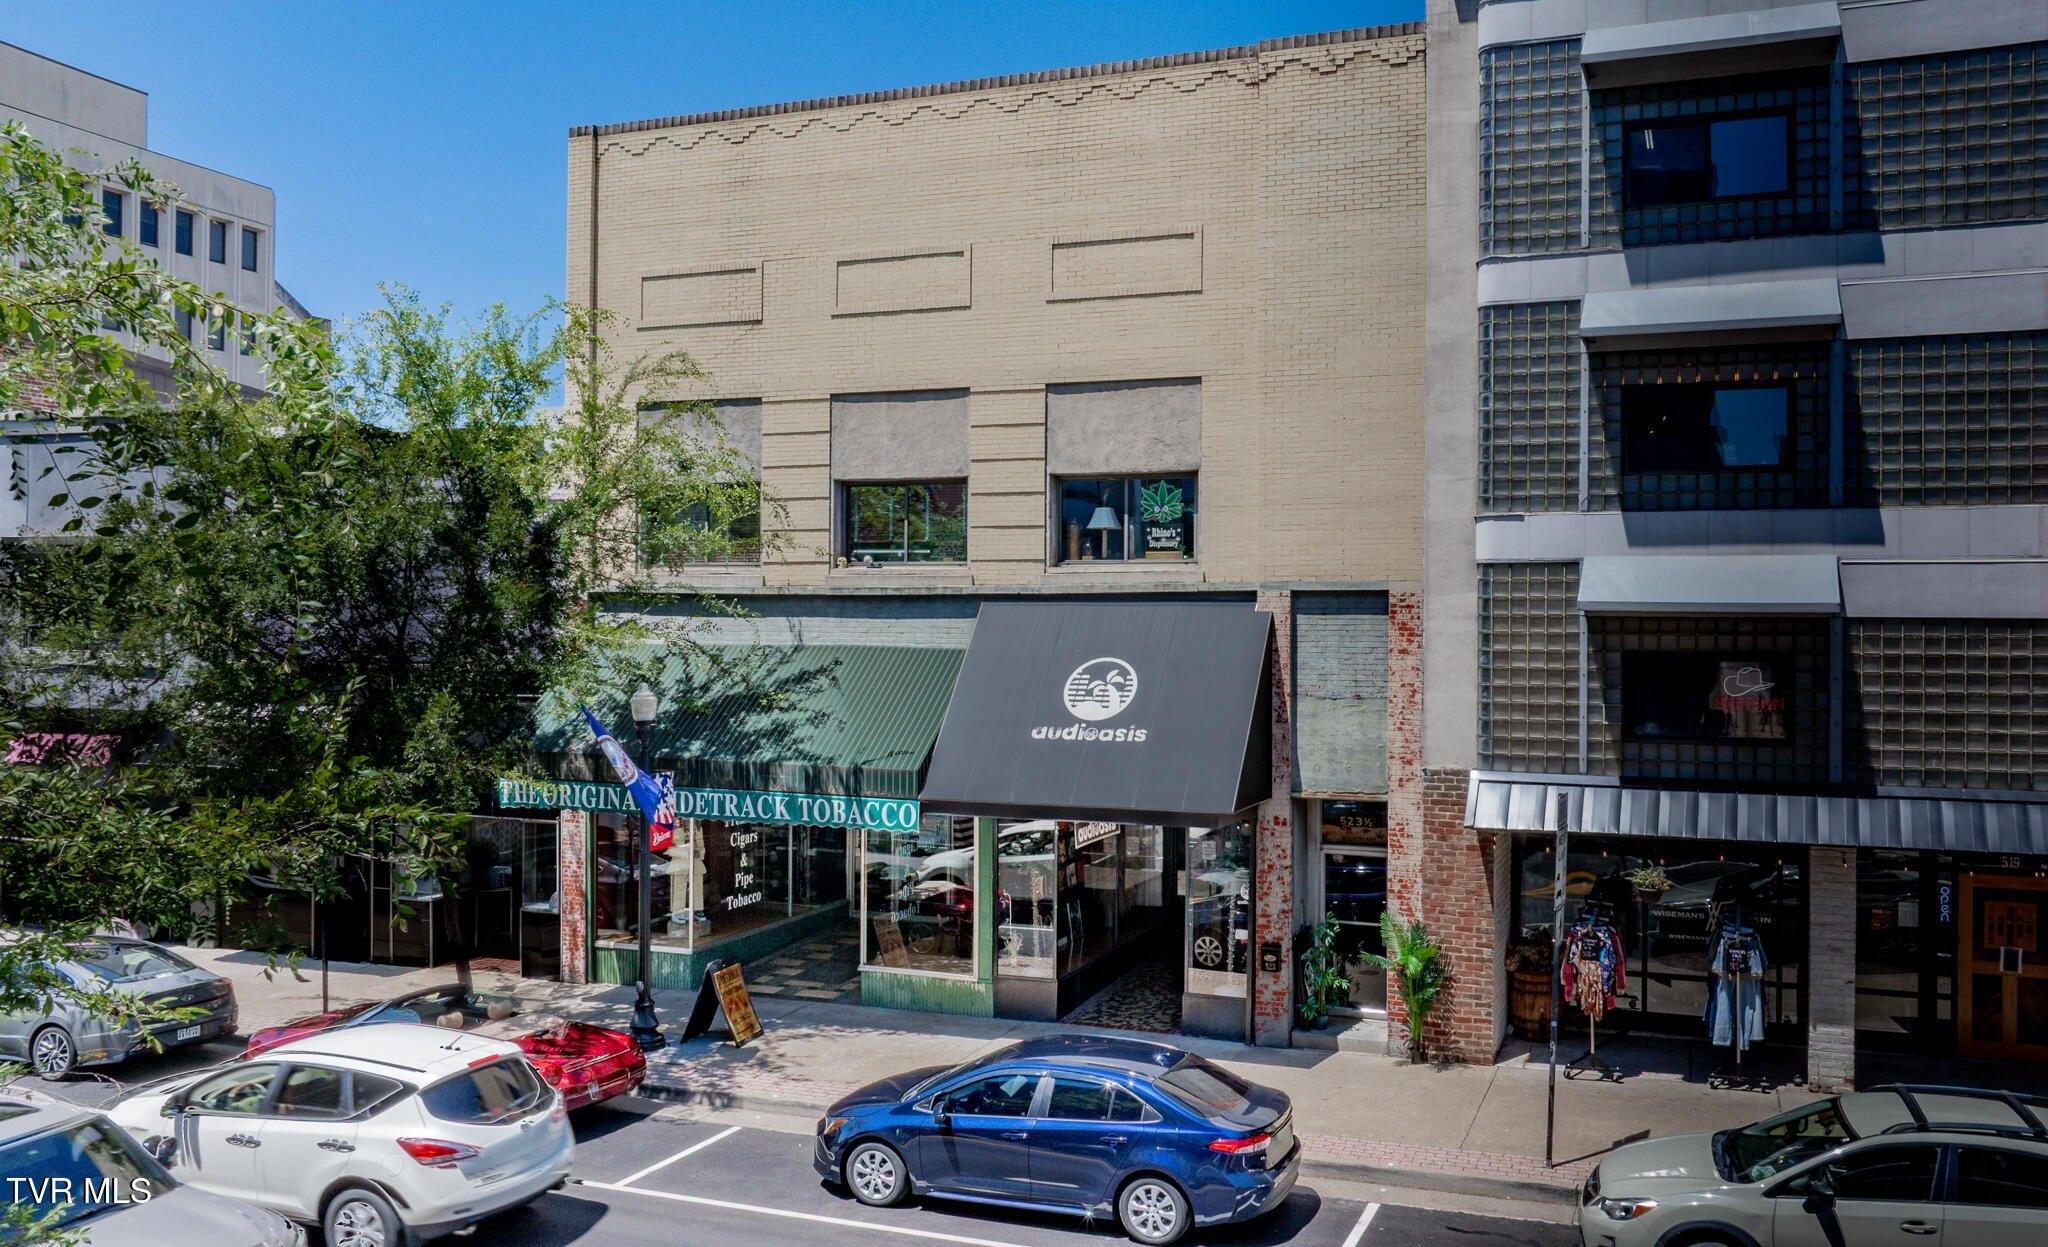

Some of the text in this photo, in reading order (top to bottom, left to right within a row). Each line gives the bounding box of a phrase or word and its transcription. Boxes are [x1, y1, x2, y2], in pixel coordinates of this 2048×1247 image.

[1151, 527, 1176, 537] Rhino's
[1149, 539, 1179, 549] Dispensary
[1031, 723, 1148, 742] audioasis
[500, 780, 917, 827] THE ORIGINA IDETRACK TOBACCO
[730, 830, 758, 848] Cigars
[1078, 822, 1117, 842] audioasis
[740, 853, 748, 866] &
[2001, 857, 2020, 868] 519
[735, 872, 754, 888] Pipe
[726, 890, 762, 911] Tobacco
[1940, 886, 1950, 922] open
